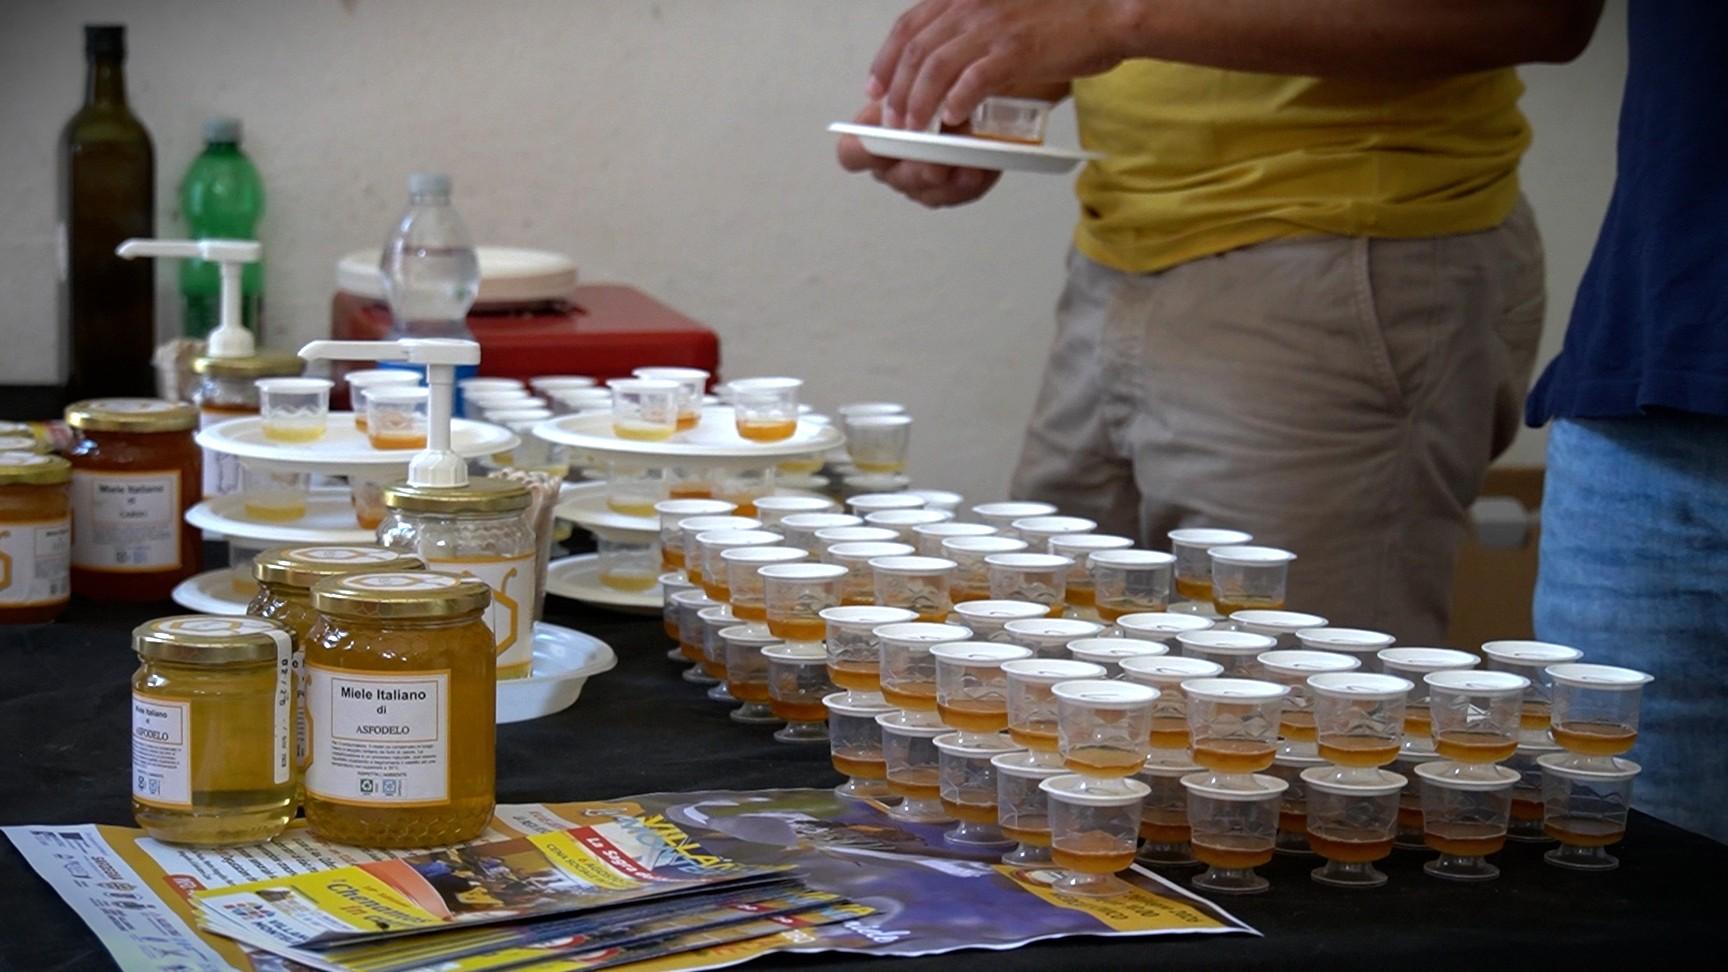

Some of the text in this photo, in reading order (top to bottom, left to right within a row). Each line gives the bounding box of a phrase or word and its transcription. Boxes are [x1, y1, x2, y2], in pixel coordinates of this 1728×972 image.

[341, 686, 427, 701] Miele Italiano
[376, 705, 387, 715] di
[356, 725, 410, 736] ASFODELO
